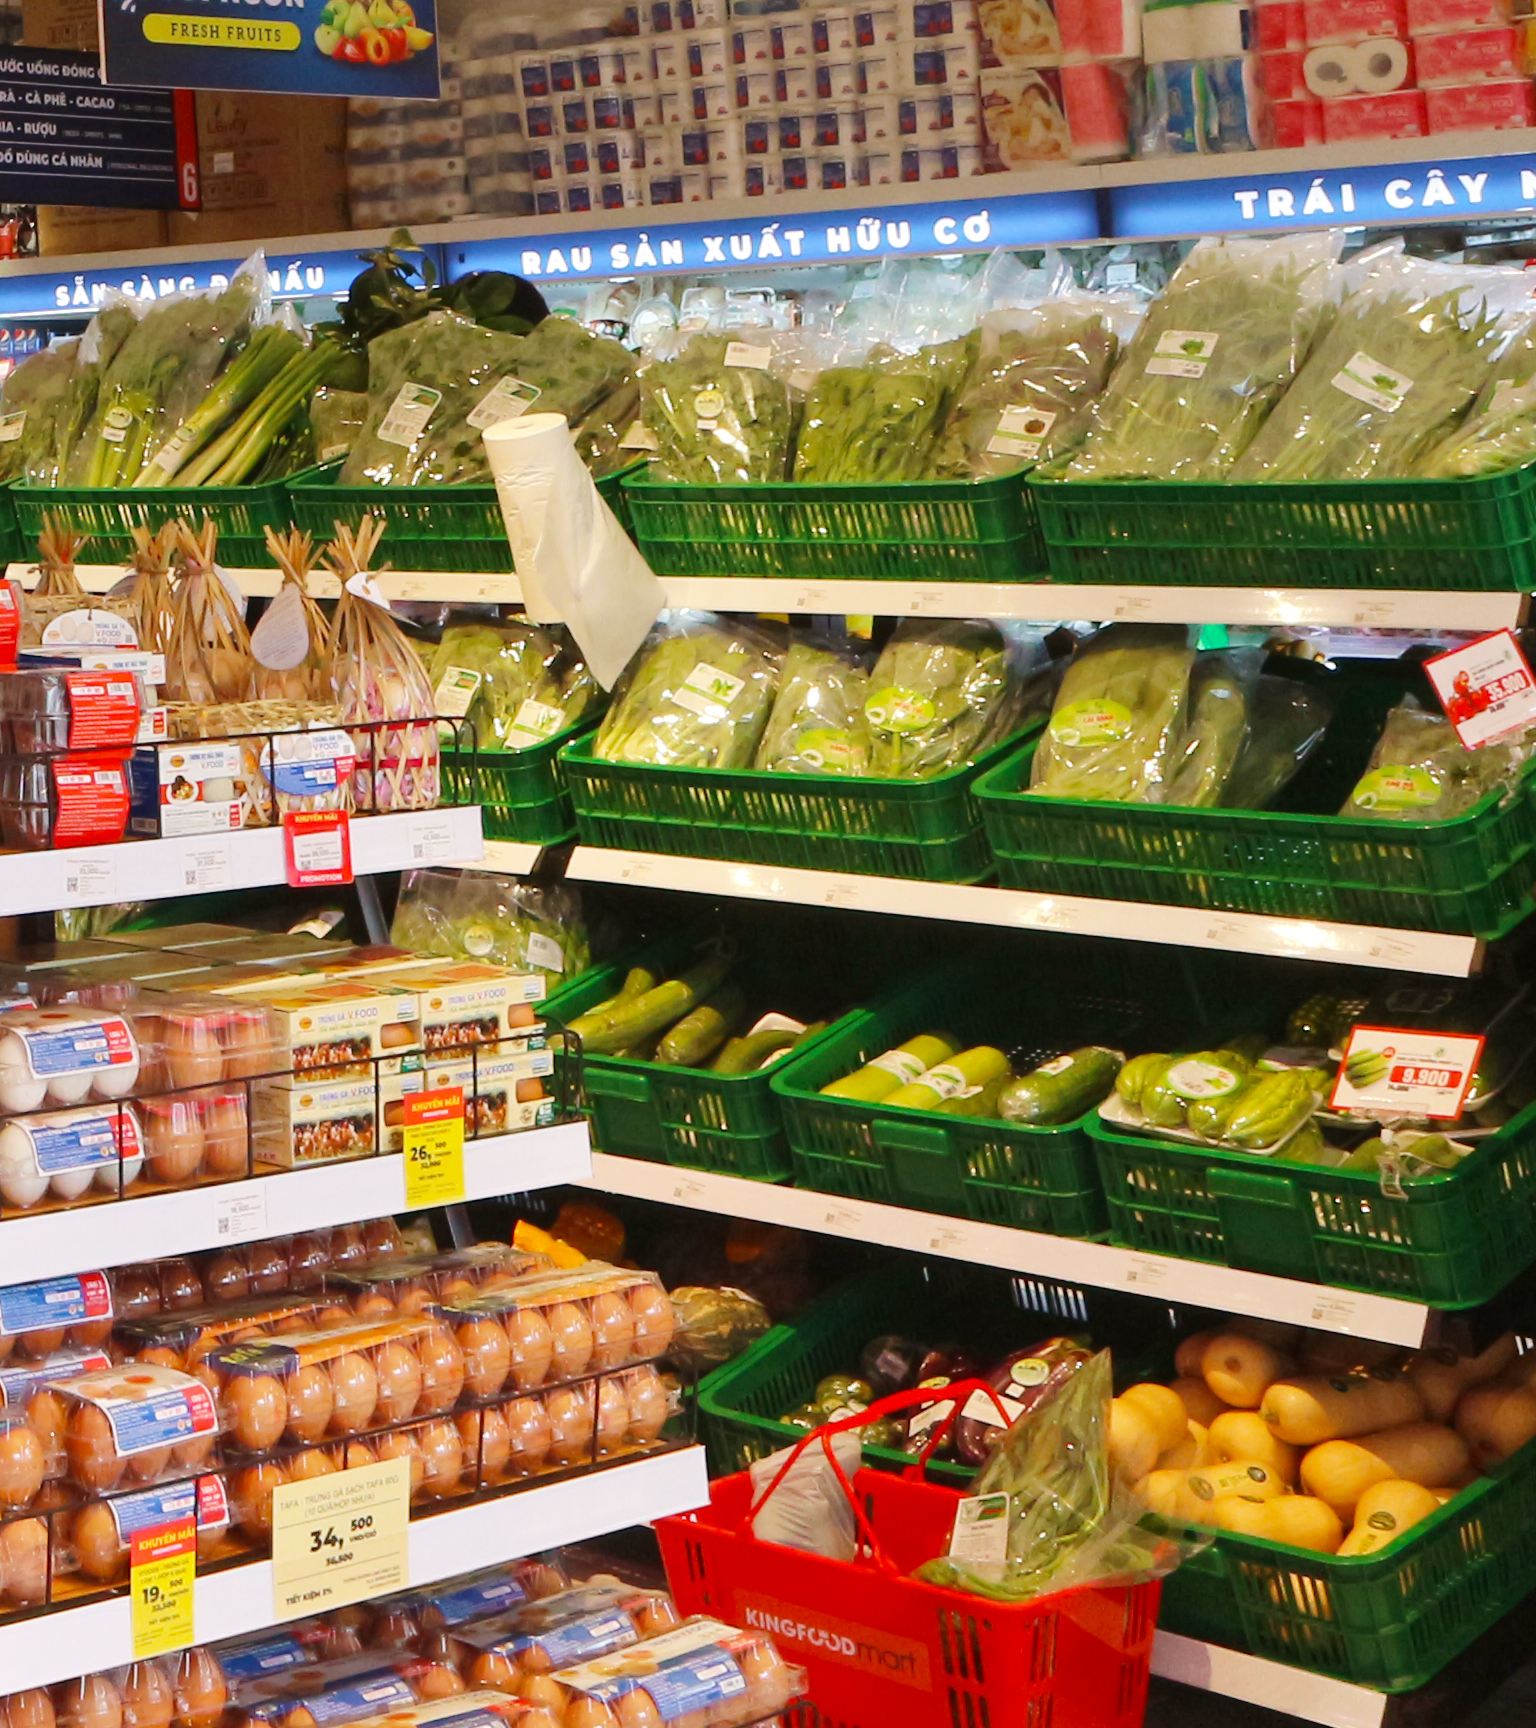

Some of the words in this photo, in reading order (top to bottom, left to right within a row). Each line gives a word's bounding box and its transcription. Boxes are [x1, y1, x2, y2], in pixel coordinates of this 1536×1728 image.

[170, 22, 221, 39] FRESH
[227, 24, 283, 42] FRUITS
[27, 60, 59, 76] UỐNG
[62, 64, 94, 78] ĐÓNG
[25, 90, 41, 105] CÀ
[44, 92, 67, 107] PHÊ
[76, 98, 115, 110] CACAO
[24, 122, 57, 138] RƯỢU
[17, 150, 49, 165] DÙNG
[52, 151, 67, 166] CÁ
[70, 153, 103, 168] NHÂN
[183, 162, 198, 202] 6
[1234, 177, 1356, 219] TRÁI
[1384, 169, 1488, 209] CÂY
[521, 245, 593, 276] RAU
[610, 233, 685, 269] SẢN
[703, 223, 805, 263] XUẤT
[826, 218, 912, 253] HỮU
[933, 210, 992, 245] CƠ
[55, 276, 107, 306] SẴN
[1402, 1068, 1450, 1087] 9.900
[310, 1527, 345, 1552] 34,
[350, 1515, 374, 1531] 500
[142, 1585, 165, 1604] 19,
[746, 1608, 918, 1673] KINGFOODmart
